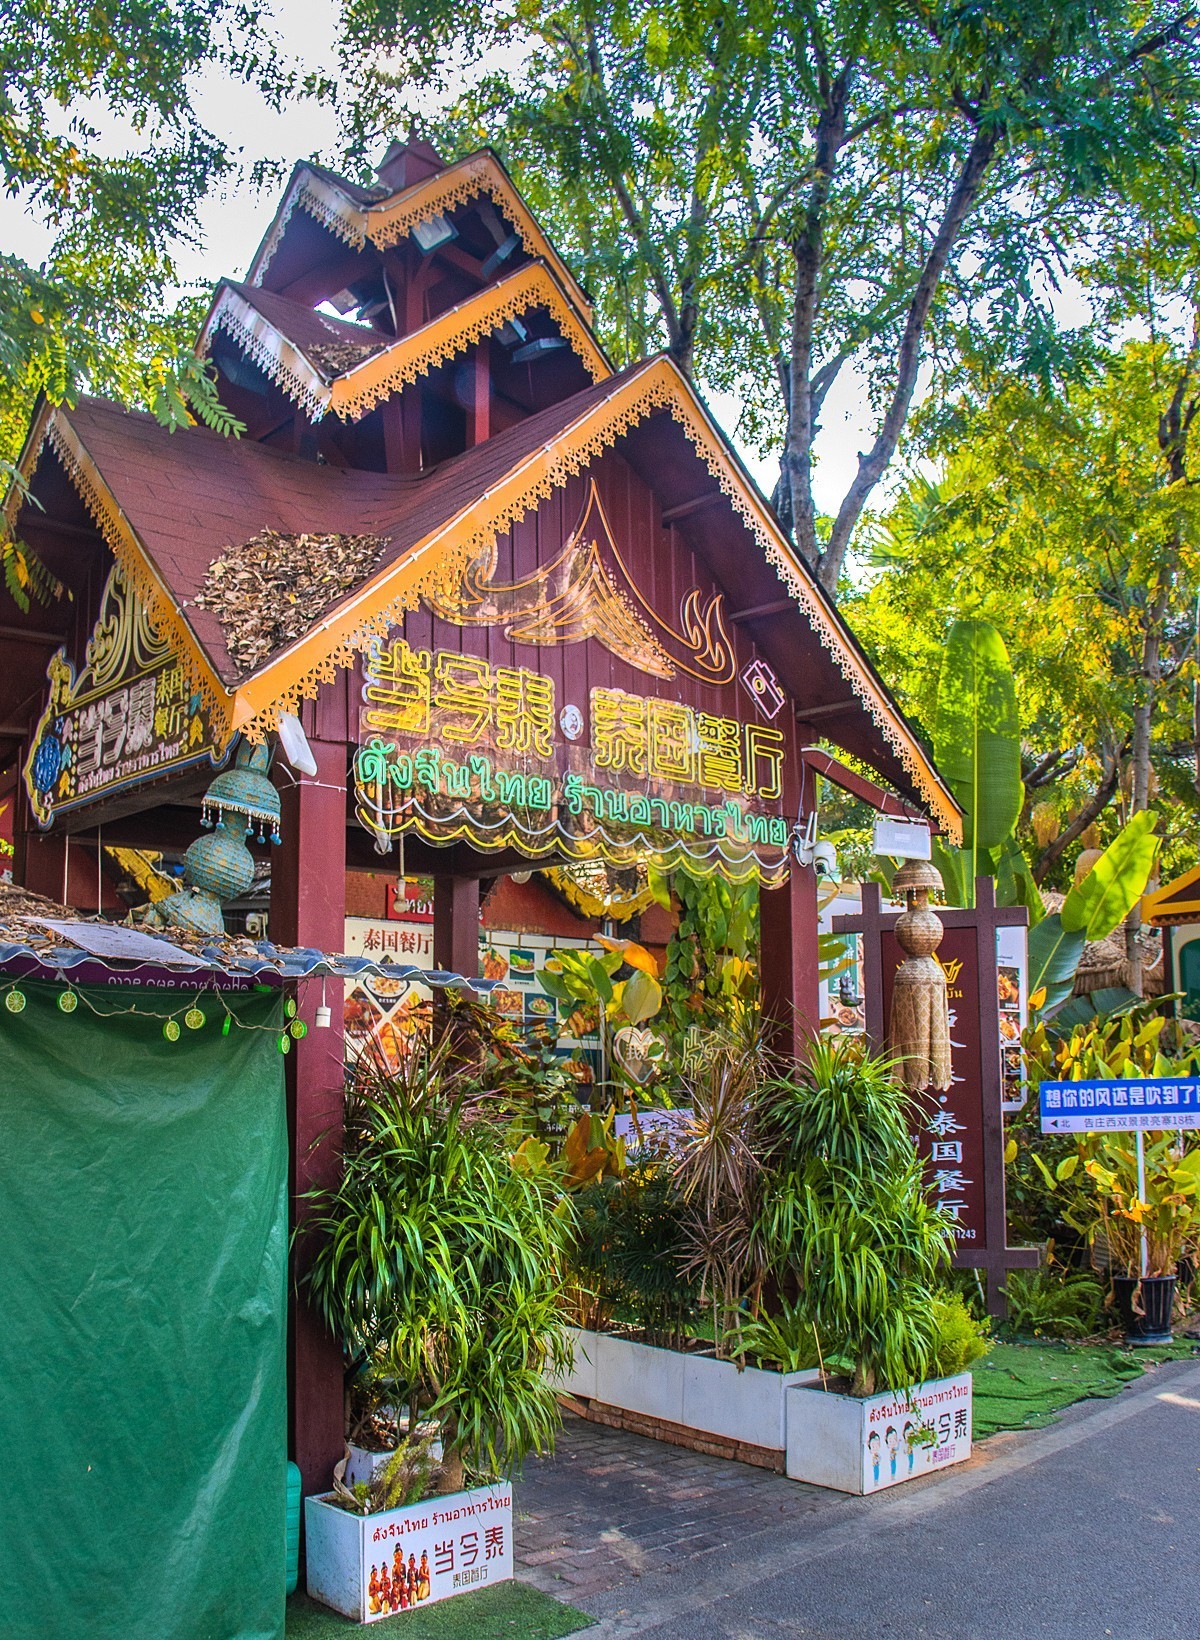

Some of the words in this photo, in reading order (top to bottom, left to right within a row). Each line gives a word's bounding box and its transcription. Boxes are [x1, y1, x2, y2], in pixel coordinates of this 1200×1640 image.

[594, 690, 784, 800] 泰国餐厅
[564, 774, 788, 847] ร้านอาหารไทย
[1045, 1084, 1200, 1109] 想你的风还是吹到了
[432, 1495, 511, 1527] ร้านอาหารไทย
[434, 1526, 504, 1576] 当今泰
